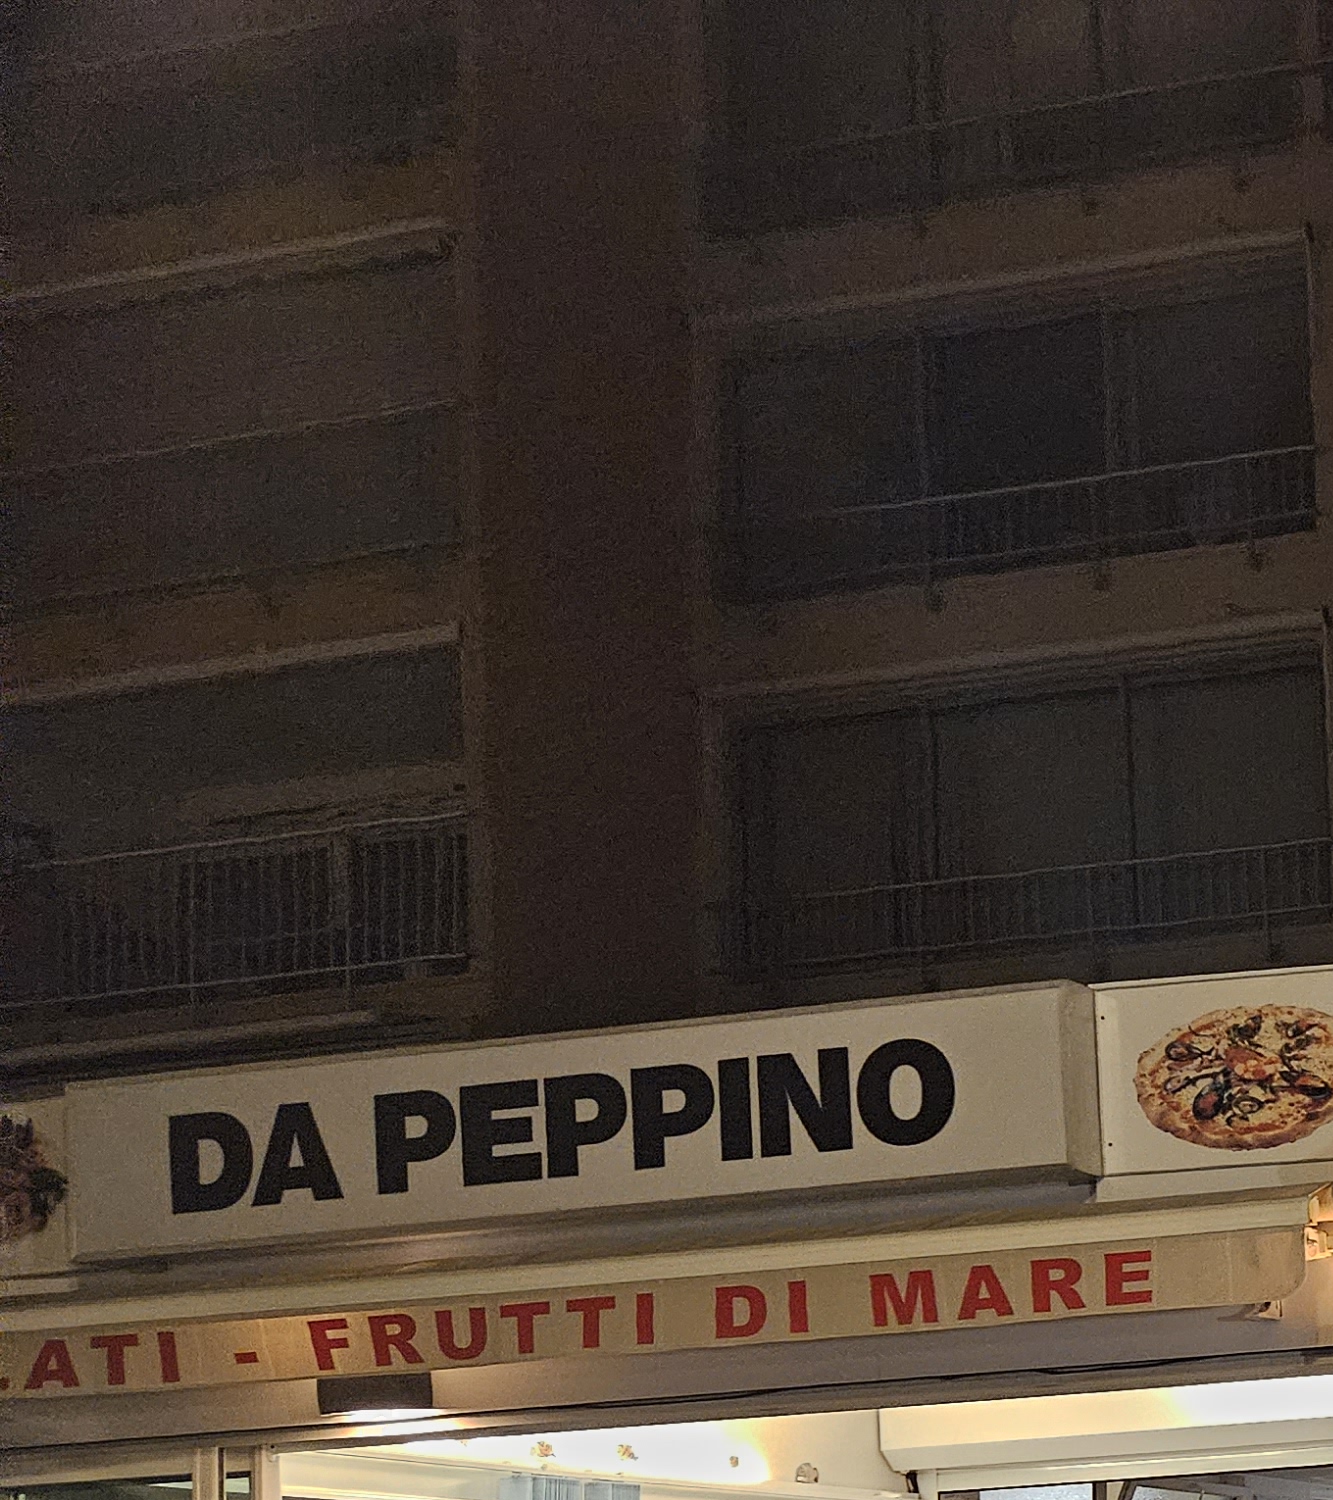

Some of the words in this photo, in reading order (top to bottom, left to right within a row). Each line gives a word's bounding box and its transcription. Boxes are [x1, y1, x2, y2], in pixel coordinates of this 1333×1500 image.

[168, 1102, 343, 1214] DA
[374, 1038, 955, 1194] PEPPINO
[0, 1331, 180, 1391] ATI
[308, 1292, 654, 1370] FRUTTI
[715, 1280, 809, 1339] DI
[869, 1250, 1153, 1328] MARE
